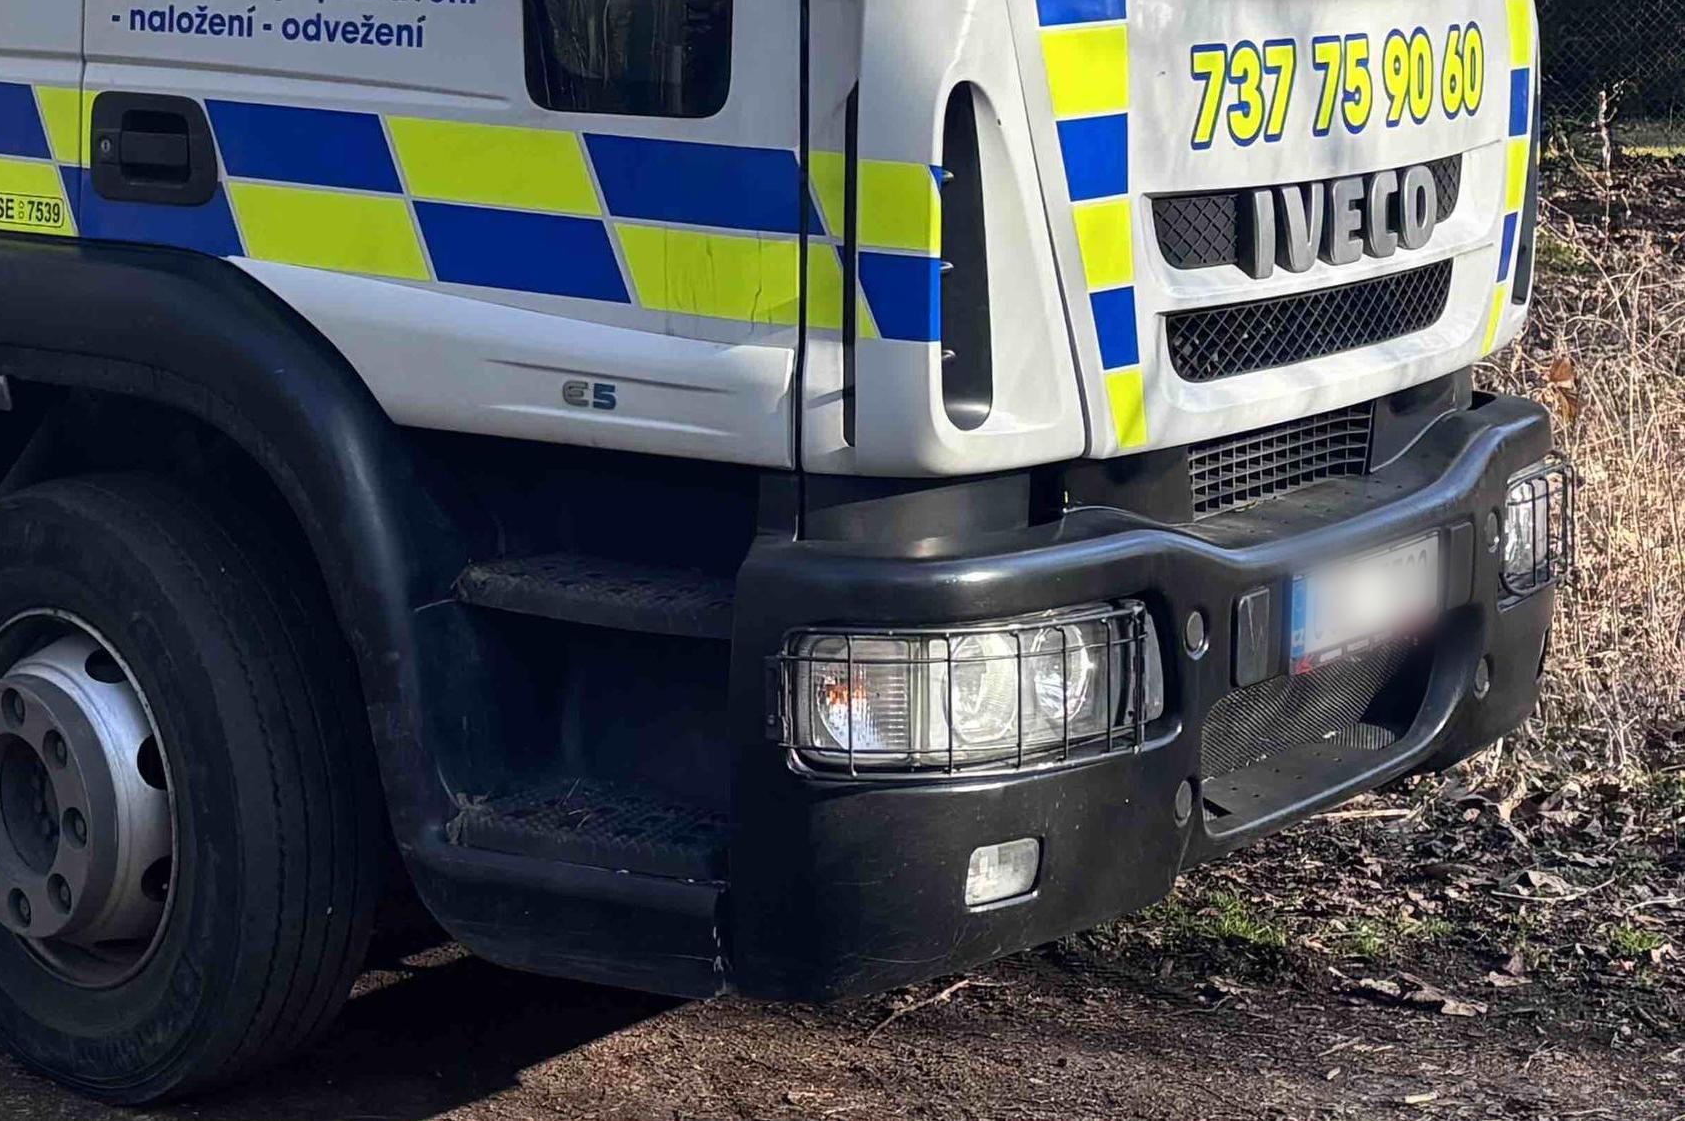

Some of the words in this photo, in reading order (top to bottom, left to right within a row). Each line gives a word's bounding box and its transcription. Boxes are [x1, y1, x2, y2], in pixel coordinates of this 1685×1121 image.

[129, 5, 256, 37] naložení
[281, 12, 426, 48] odvežení
[1190, 38, 1296, 150] 737
[1313, 32, 1372, 137] 75
[1382, 26, 1434, 128] 90
[1441, 21, 1484, 119] 60
[27, 200, 61, 223] 7539
[1251, 164, 1438, 279] IVECO
[562, 380, 616, 410] E5
